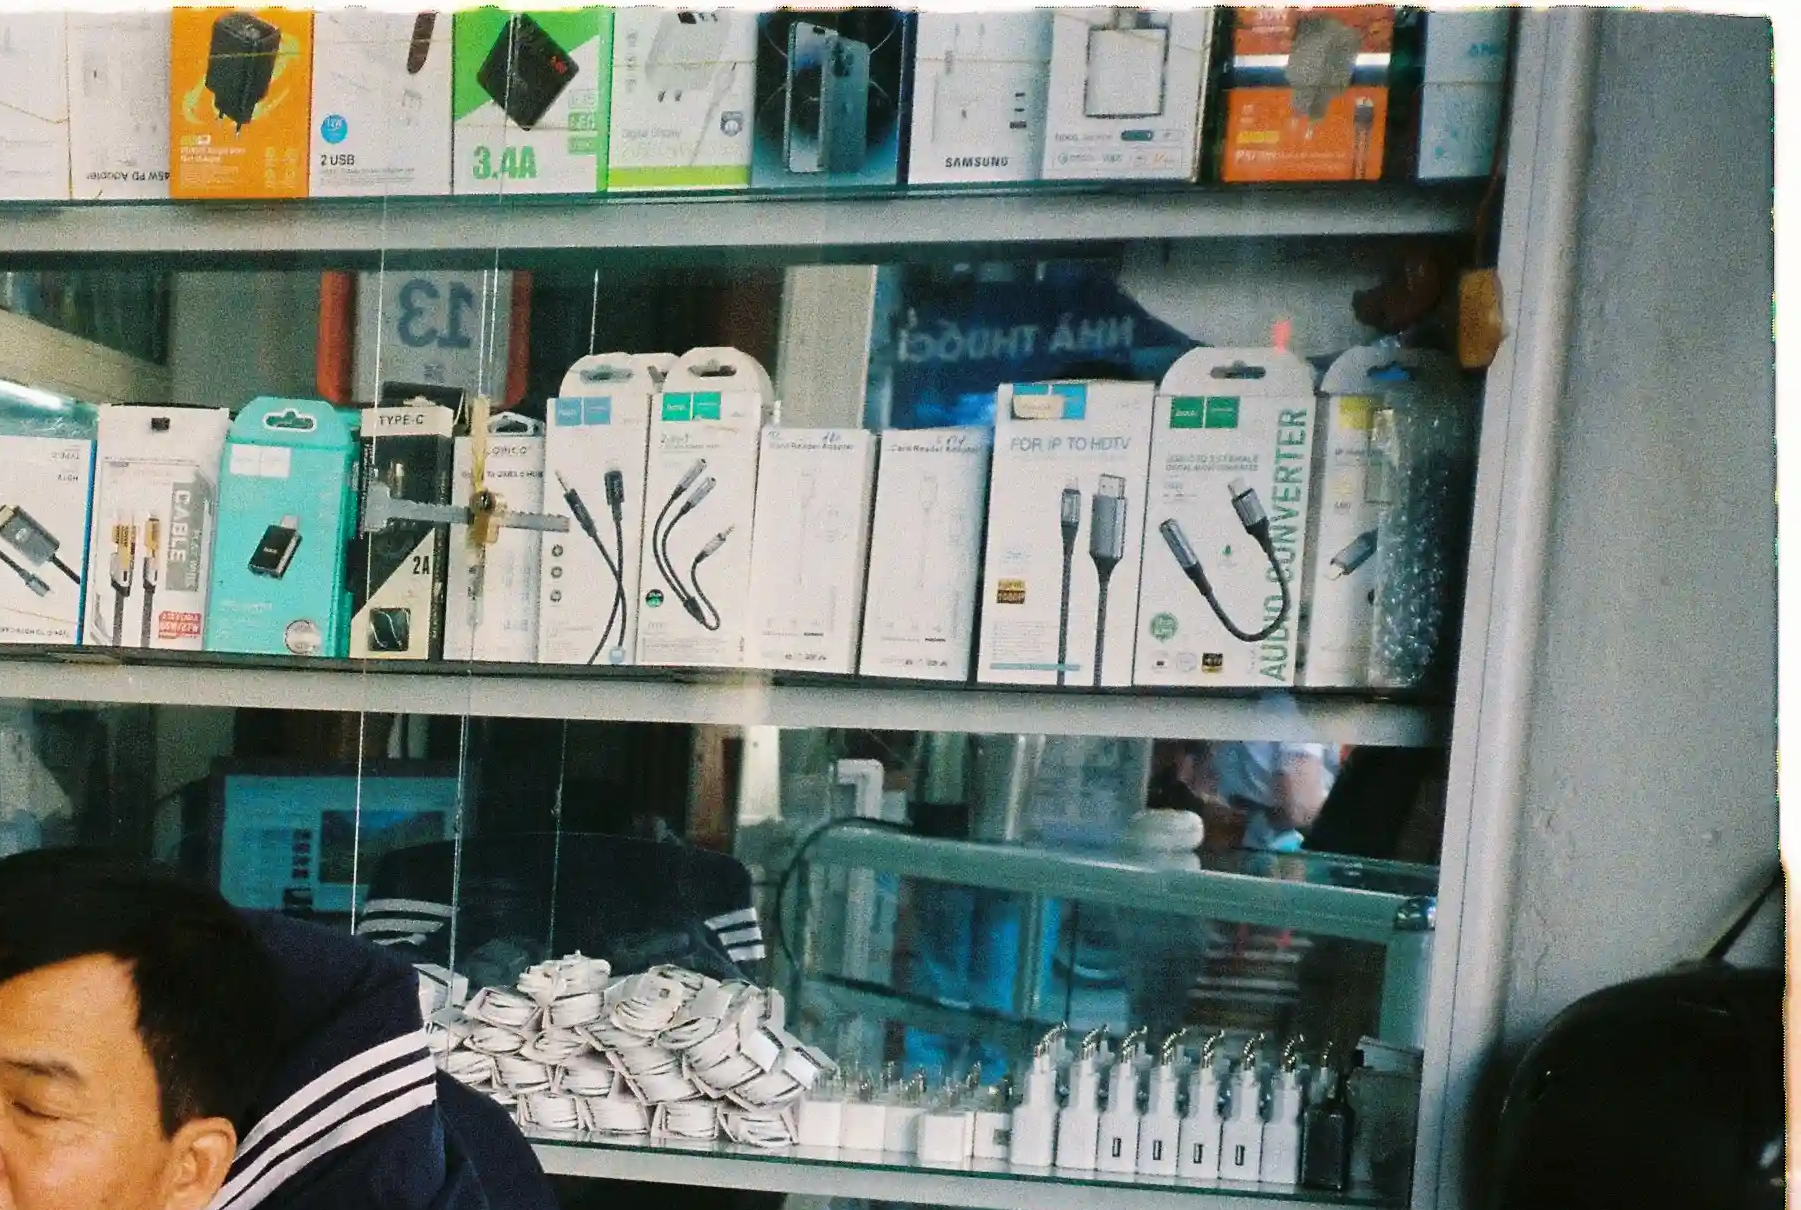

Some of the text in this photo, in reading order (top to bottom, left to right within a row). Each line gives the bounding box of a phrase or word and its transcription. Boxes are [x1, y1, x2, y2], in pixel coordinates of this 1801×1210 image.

[320, 154, 355, 166] 2 USB
[472, 145, 537, 180] 3.4A
[945, 156, 1009, 168] SAMSUNG
[378, 414, 425, 426] TYPE-C
[1010, 436, 1044, 451] FOR
[1066, 436, 1086, 450] TO
[1090, 436, 1132, 450] HDTV
[1266, 408, 1307, 583] CONVERTER
[168, 490, 192, 563] CABLE
[412, 555, 430, 575] 2A
